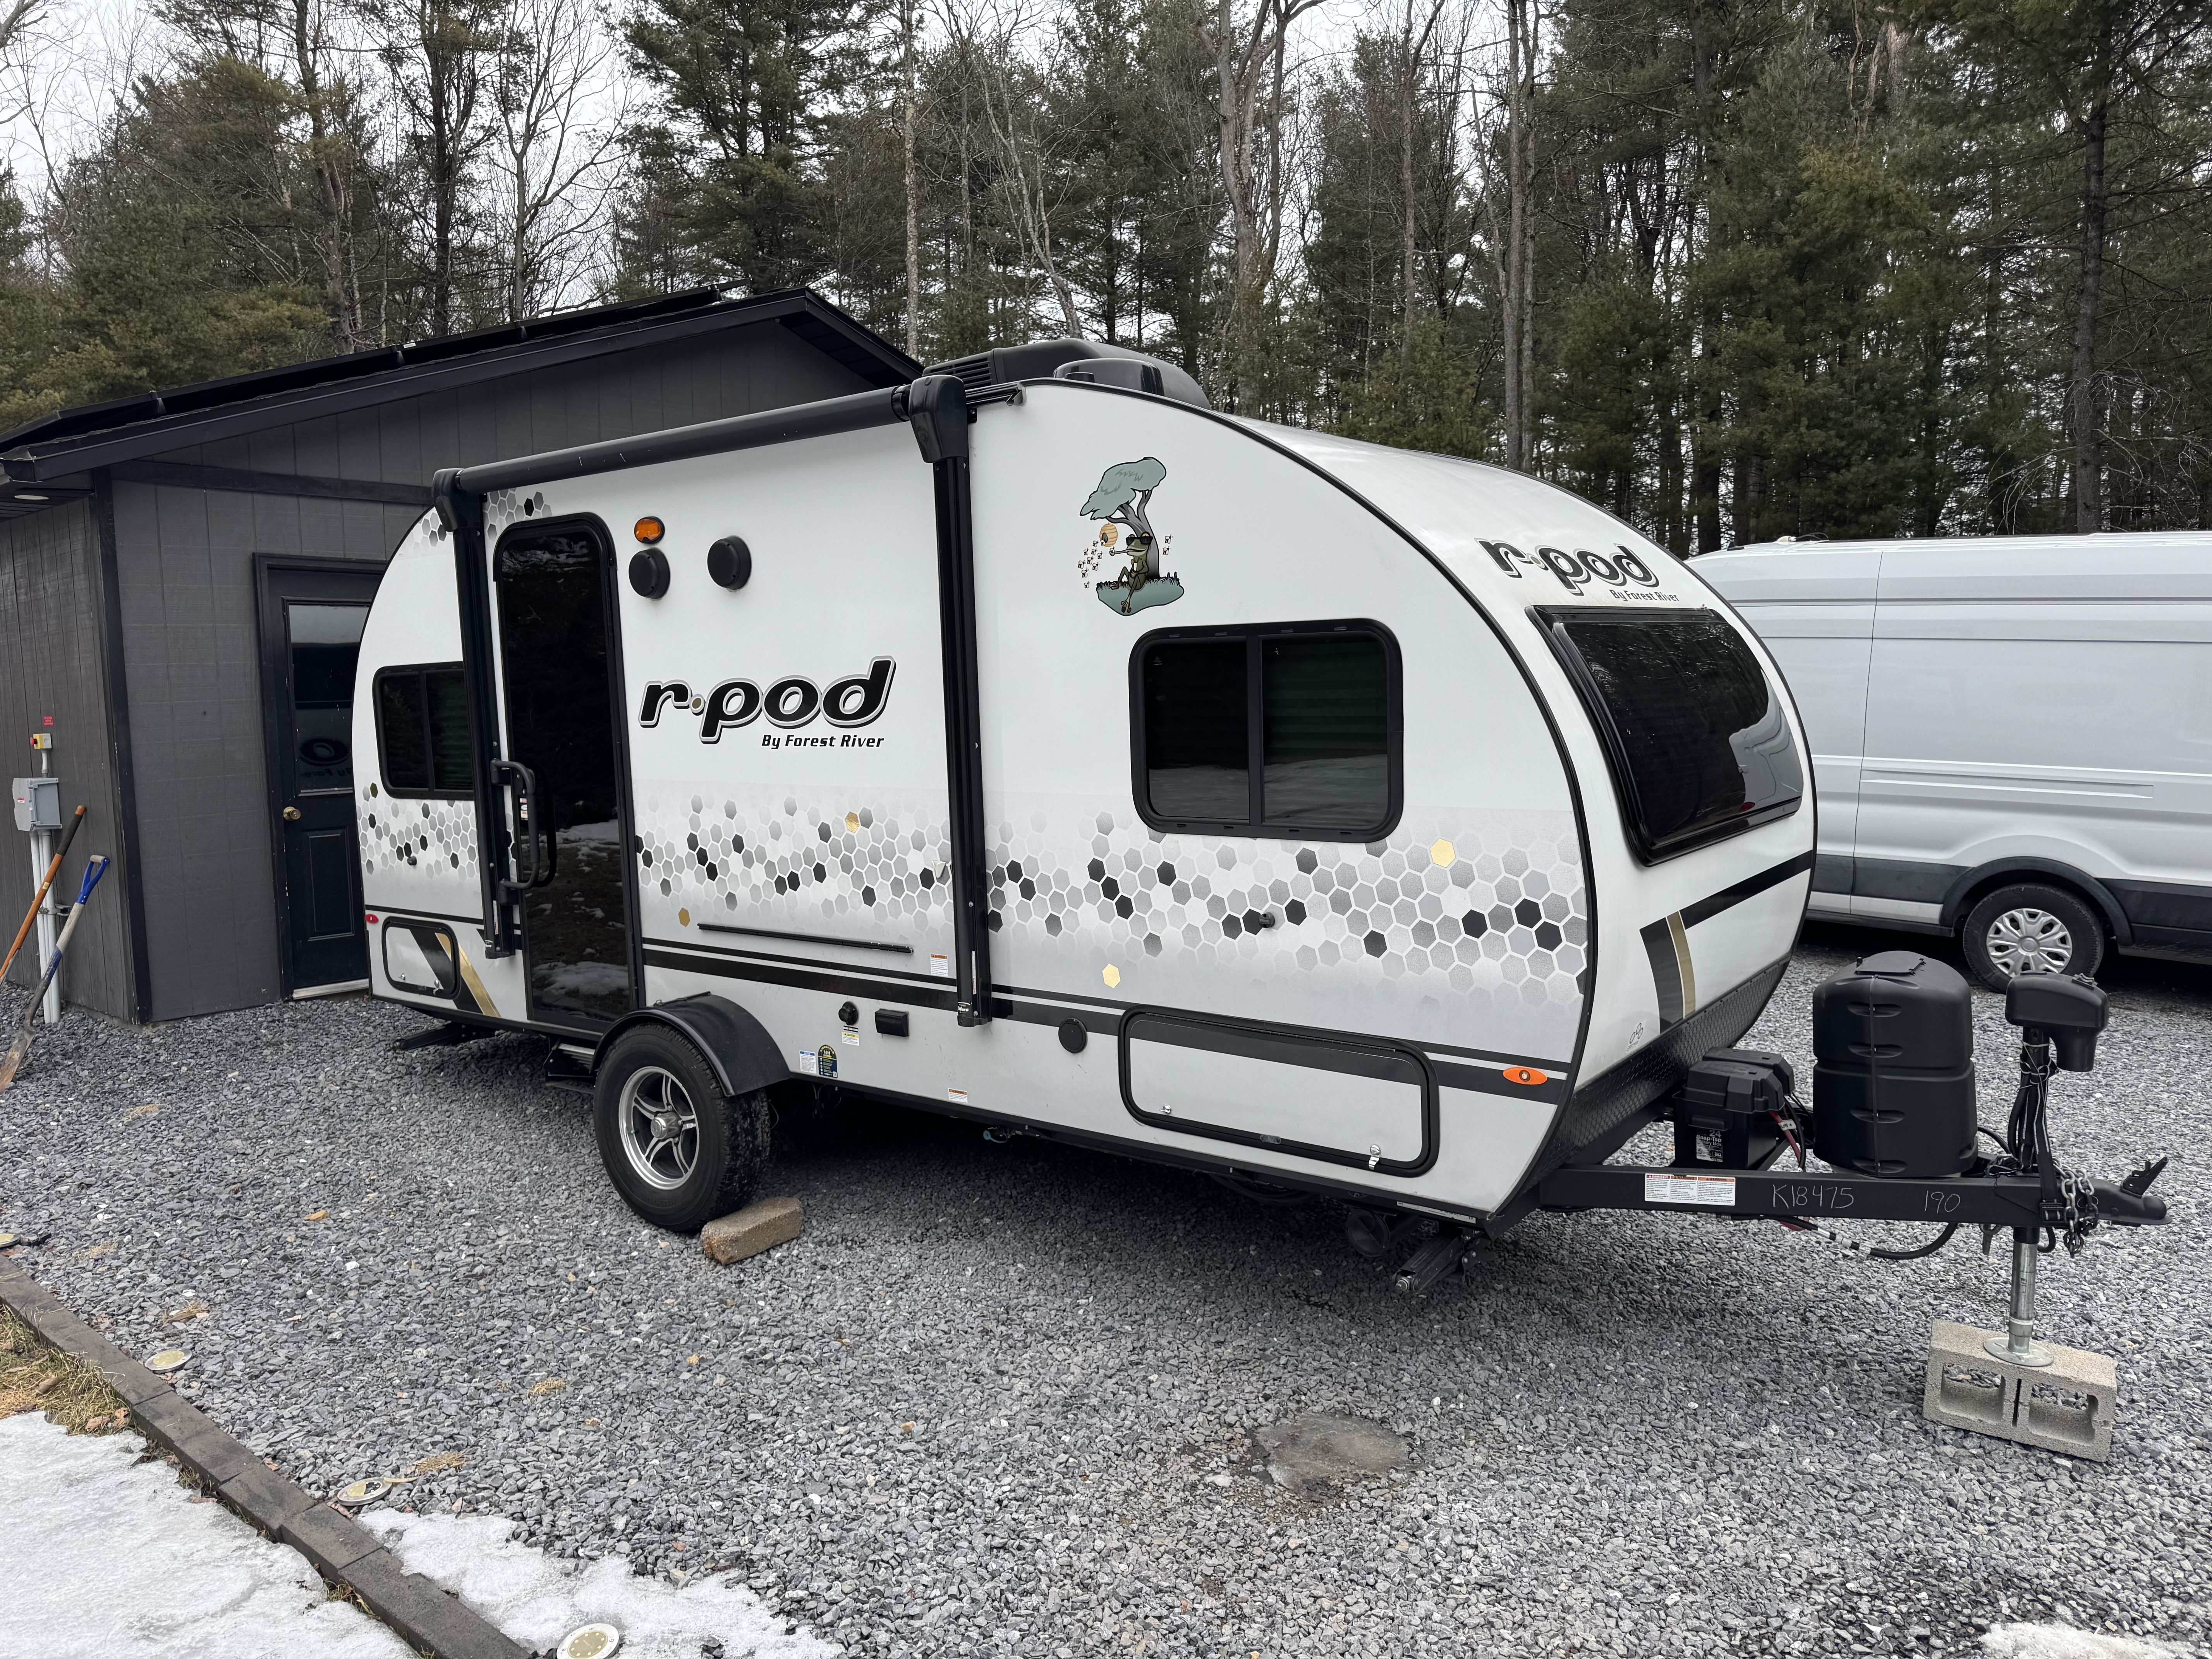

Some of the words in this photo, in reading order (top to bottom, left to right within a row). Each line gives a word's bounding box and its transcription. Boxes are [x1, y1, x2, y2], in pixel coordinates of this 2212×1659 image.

[1609, 589, 1628, 601] By
[1623, 590, 1657, 600] Forest
[1654, 592, 1679, 601] River
[762, 735, 781, 749] By
[785, 735, 836, 747] Forest
[840, 735, 884, 747] River
[1696, 1134, 1722, 1143] Snap-Top
[1709, 1130, 1722, 1138] 24
[1924, 1190, 1961, 1214] 190
